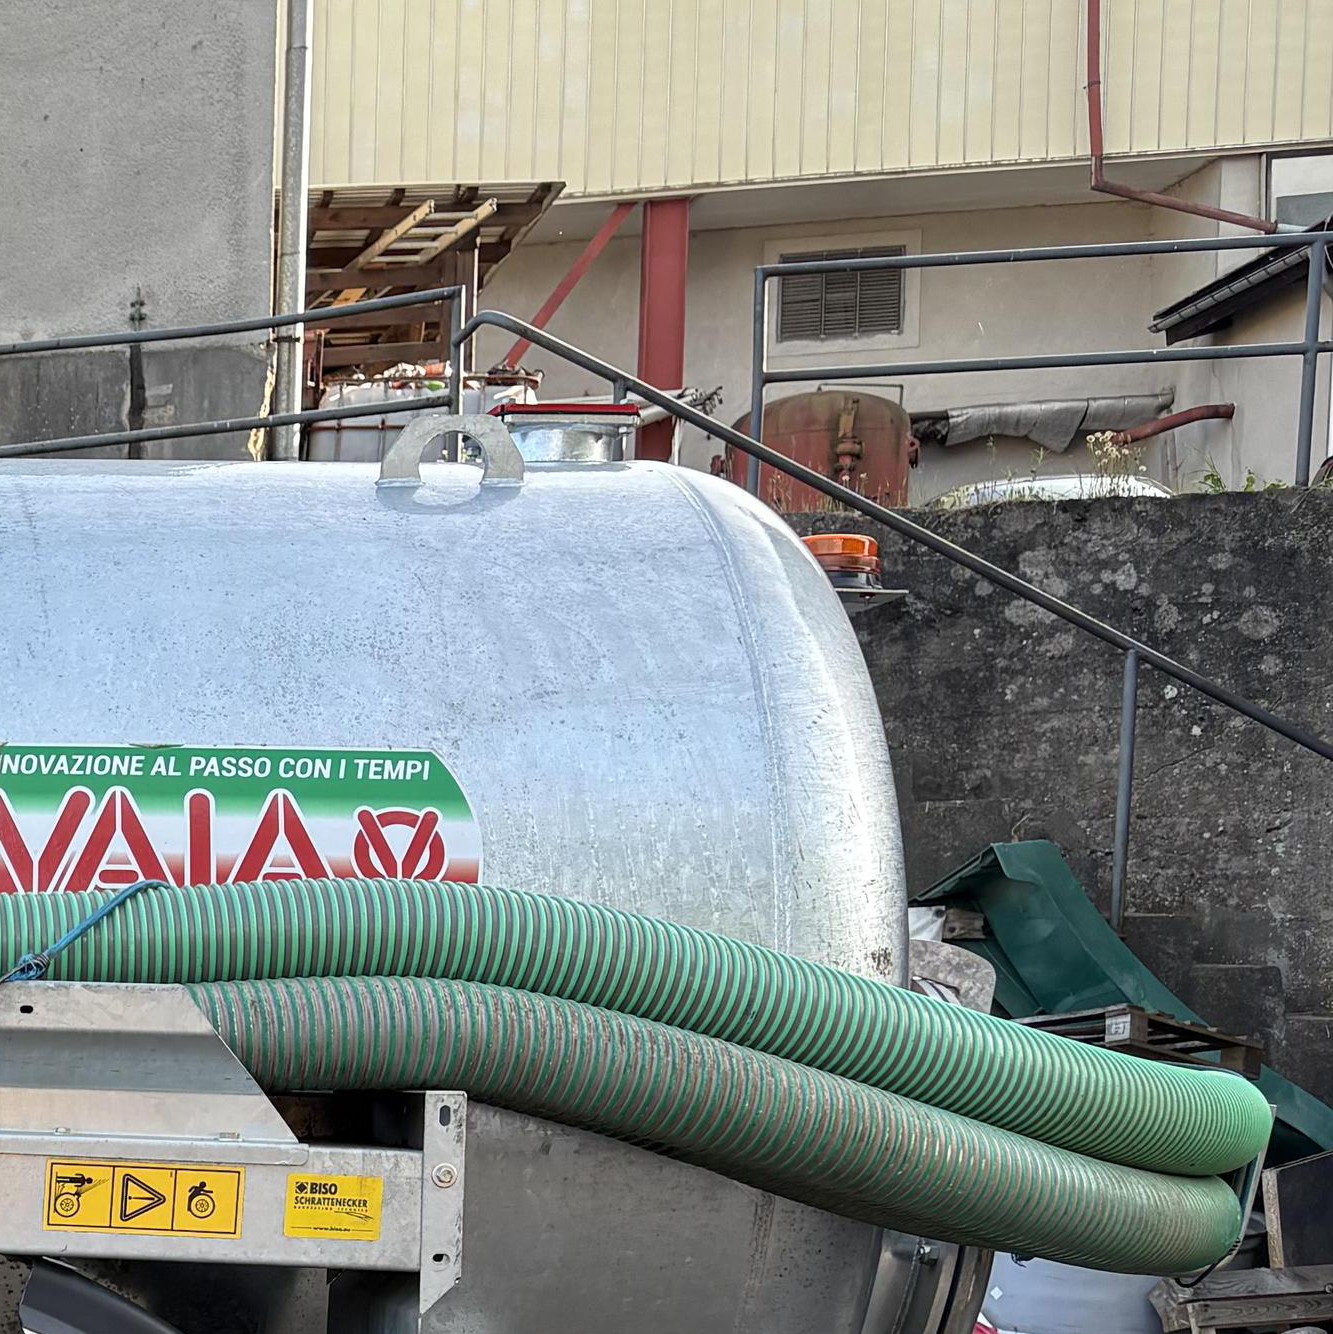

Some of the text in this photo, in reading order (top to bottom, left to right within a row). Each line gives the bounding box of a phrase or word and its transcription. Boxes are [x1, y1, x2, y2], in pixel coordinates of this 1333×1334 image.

[151, 754, 183, 778] AL
[189, 755, 272, 780] PASSO
[278, 757, 333, 780] CON
[337, 758, 347, 780] I
[352, 758, 431, 781] TEMPI
[309, 1183, 338, 1195] BISO
[294, 1196, 368, 1208] SCHRATTENECKER
